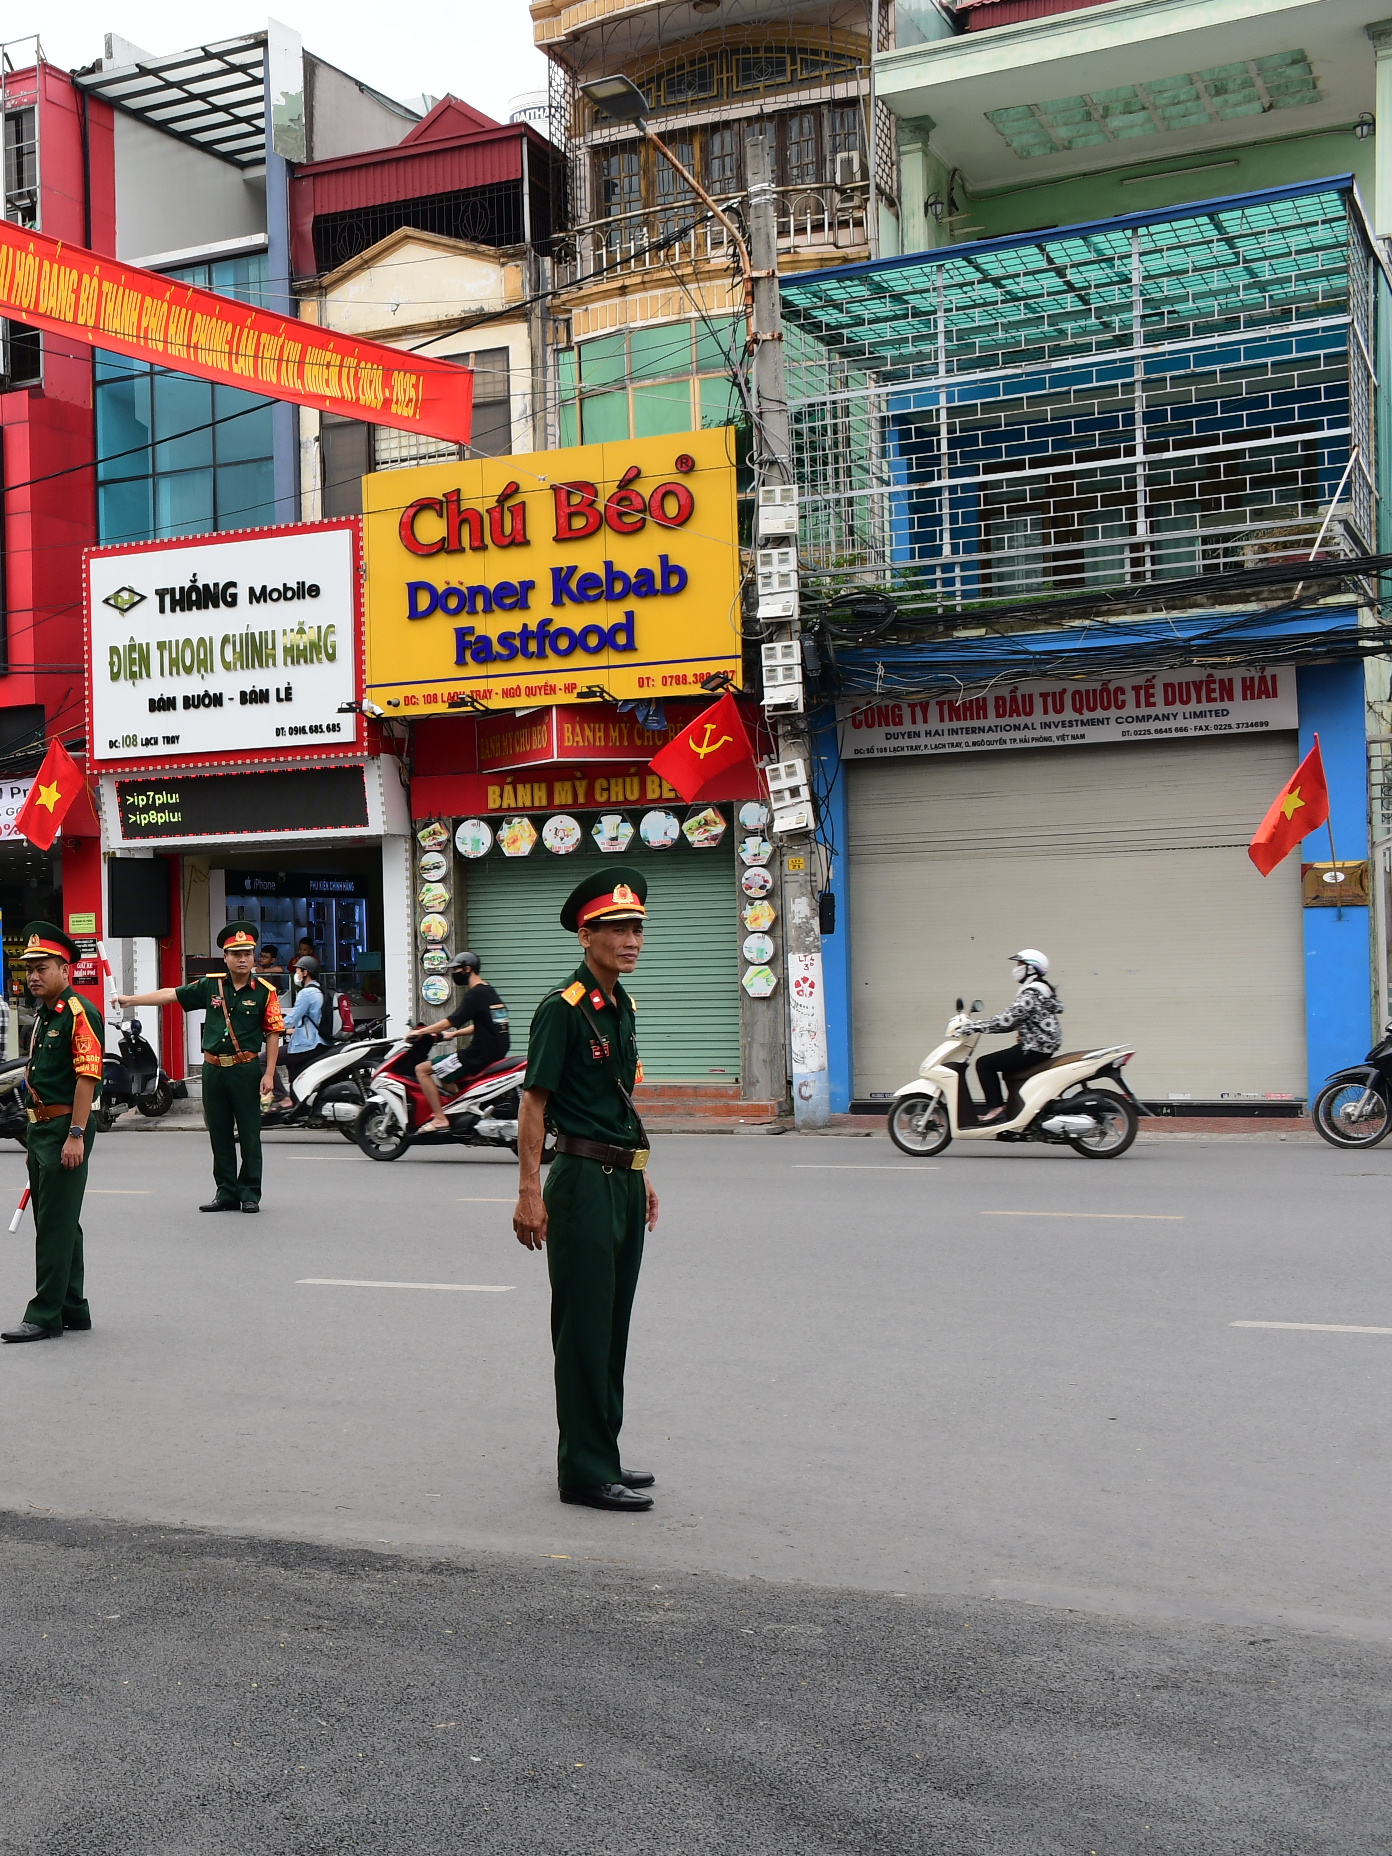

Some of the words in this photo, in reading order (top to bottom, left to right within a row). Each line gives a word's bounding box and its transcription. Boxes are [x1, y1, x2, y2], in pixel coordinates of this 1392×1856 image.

[12, 243, 39, 321] HỘI
[39, 240, 80, 320] ĐẢNG
[78, 266, 101, 341] BỘ
[100, 275, 141, 340] THÀNH
[140, 286, 175, 352] PHỐ
[168, 287, 192, 360] HẢI
[191, 305, 233, 370] PHÒNG
[232, 312, 259, 378] LẦN
[257, 325, 286, 385] THỨ
[304, 341, 342, 407] NHIỆM
[358, 360, 384, 410] 2020
[398, 480, 531, 557] Chú
[550, 465, 695, 544] Béo
[155, 572, 238, 615] THẮNG
[248, 581, 321, 606] Mobile
[549, 553, 688, 606] Kebab
[108, 636, 152, 688] ĐIỆN
[157, 636, 215, 680] THOẠI
[220, 624, 277, 671] CHÍNH
[282, 620, 338, 668] HÃNG
[453, 610, 638, 666] Fastfood
[148, 690, 177, 713] BÁN
[182, 690, 224, 710] BUÔN
[239, 684, 270, 705] BÁN
[275, 681, 293, 702] LẺ
[422, 693, 438, 704] 108
[470, 689, 493, 700] TRAY
[501, 685, 521, 699] NGÔ
[525, 680, 557, 697] QUYỀN
[564, 682, 578, 694] HP
[638, 677, 656, 689] ĐT:
[851, 702, 903, 729] CÔNG
[908, 702, 929, 725] TY
[936, 698, 987, 723] TNHH
[994, 686, 1034, 719] ĐẦU
[1045, 689, 1067, 716] TƯ
[1071, 680, 1127, 716] QUỐC
[1132, 675, 1157, 709] TẾ
[1163, 673, 1235, 708] DUYÊN
[1241, 667, 1279, 701] HẢI
[122, 734, 138, 748] 108
[162, 735, 181, 746] TRAY
[288, 723, 341, 736] 0916.685.685
[564, 717, 605, 746] BÁNH
[609, 718, 630, 746] MỲ
[885, 730, 921, 741] DUYEN
[925, 728, 945, 738] HAI
[948, 721, 1038, 737] INTERNATIONAL
[1040, 716, 1111, 730] INVESTMENT
[1115, 712, 1178, 725] COMPANY
[1183, 709, 1230, 720] LIMITED
[487, 772, 548, 809] BÁNH
[554, 770, 589, 805] MỲ
[594, 767, 641, 803] CHÚ
[253, 878, 276, 891] iPhone
